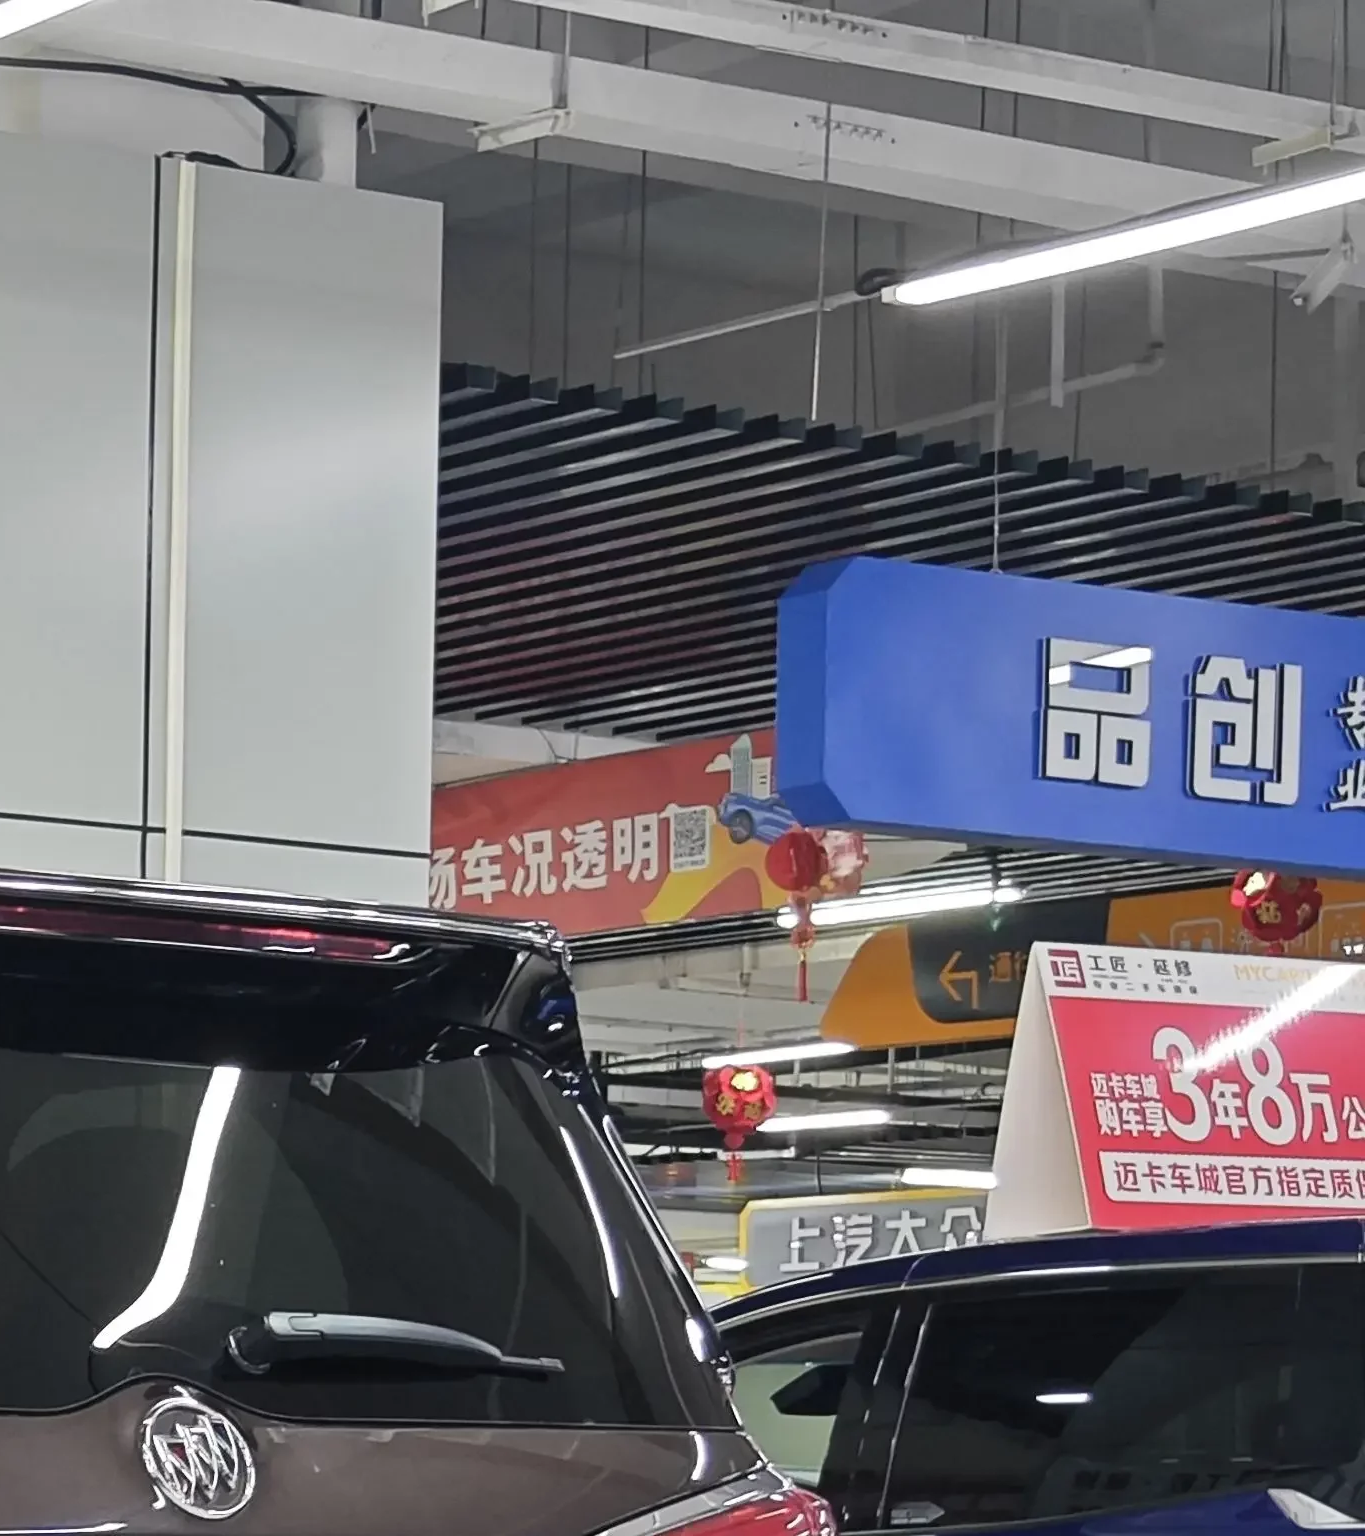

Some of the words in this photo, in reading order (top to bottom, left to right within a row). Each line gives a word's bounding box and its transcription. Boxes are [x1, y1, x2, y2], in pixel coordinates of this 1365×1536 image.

[1035, 636, 1304, 806] 品创
[779, 1206, 982, 1273] 上汽大众
